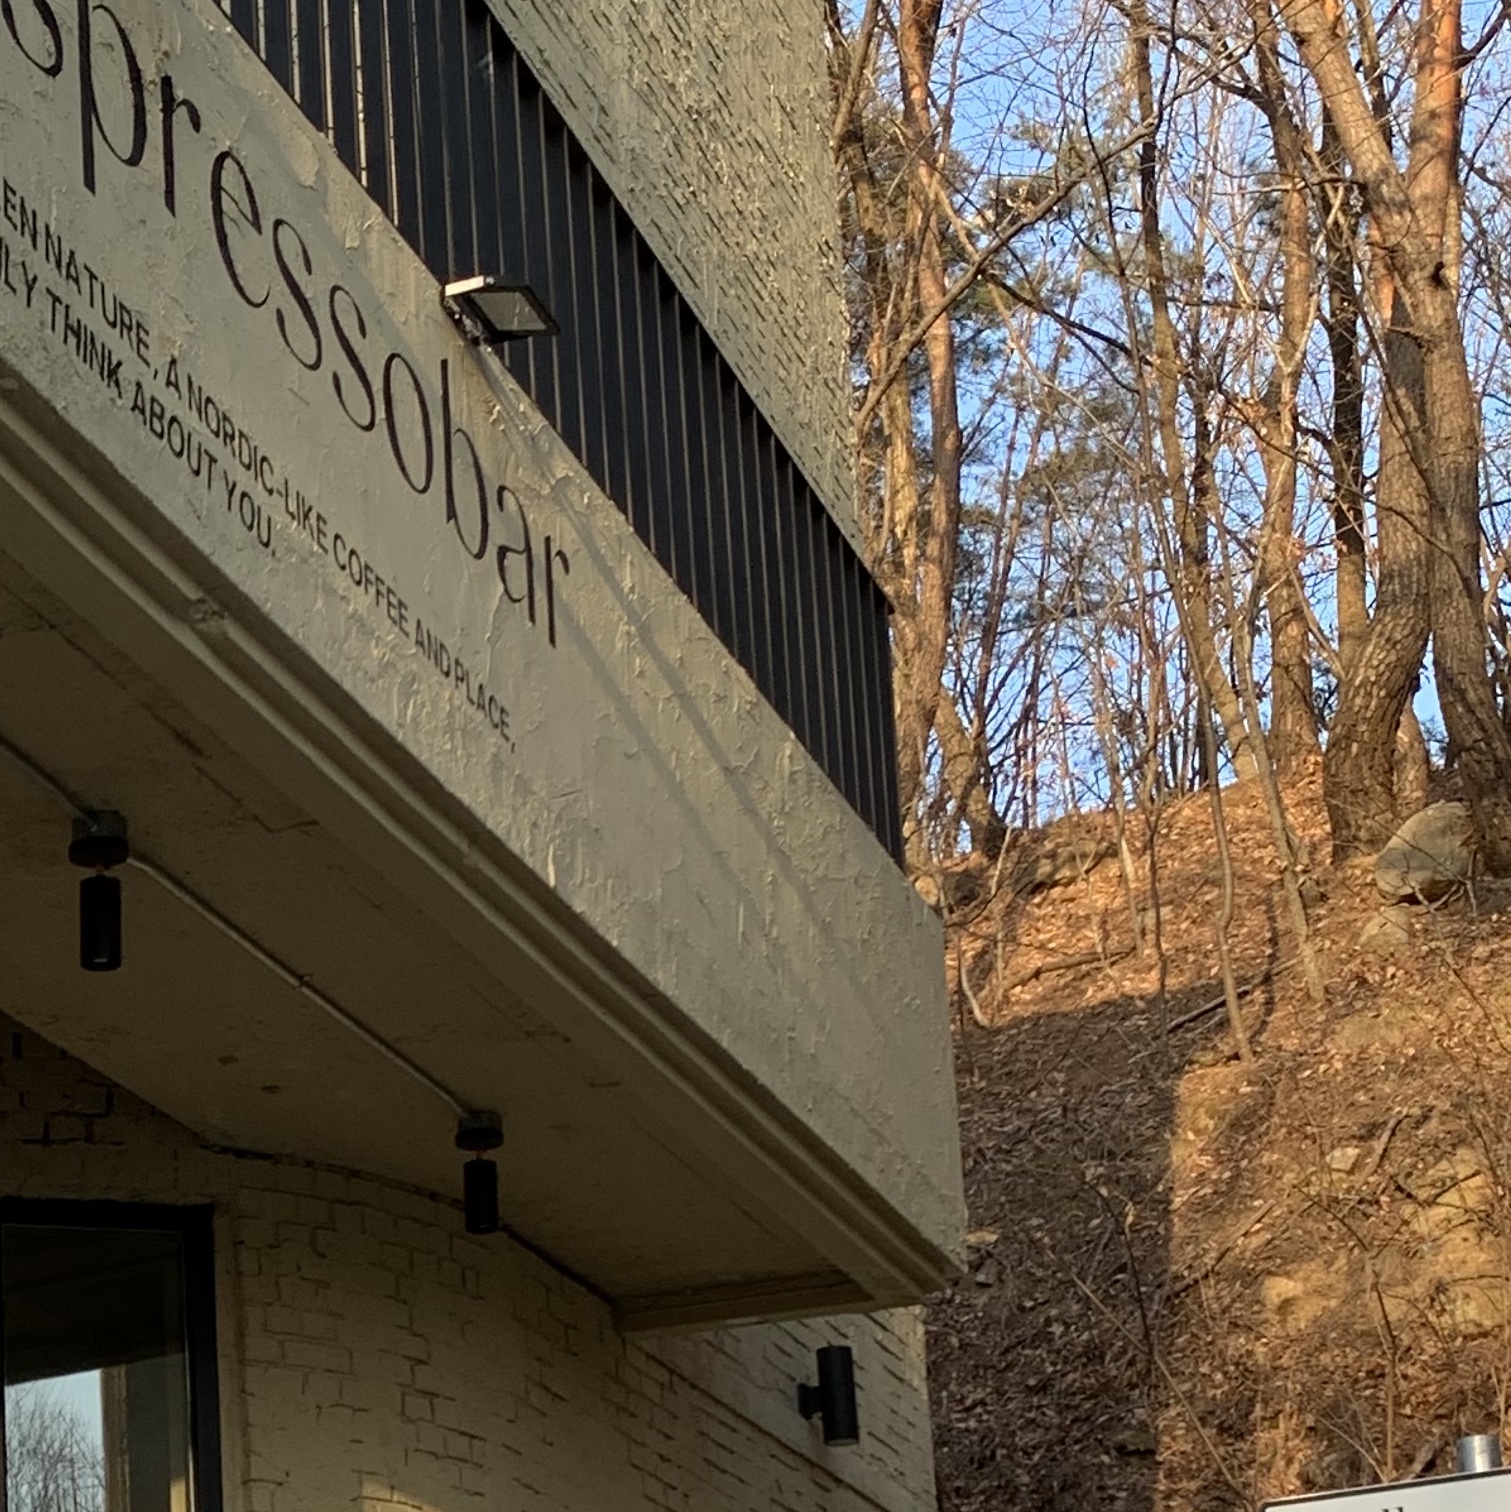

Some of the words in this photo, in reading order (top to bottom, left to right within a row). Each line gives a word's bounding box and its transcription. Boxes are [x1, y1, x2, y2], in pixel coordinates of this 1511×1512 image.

[46, 287, 123, 399] THINK
[130, 381, 218, 490] ABOUT
[165, 357, 182, 400] A
[188, 373, 328, 554] NORDIC-LIKE
[333, 533, 409, 638] COFFEE
[415, 618, 451, 678] AND
